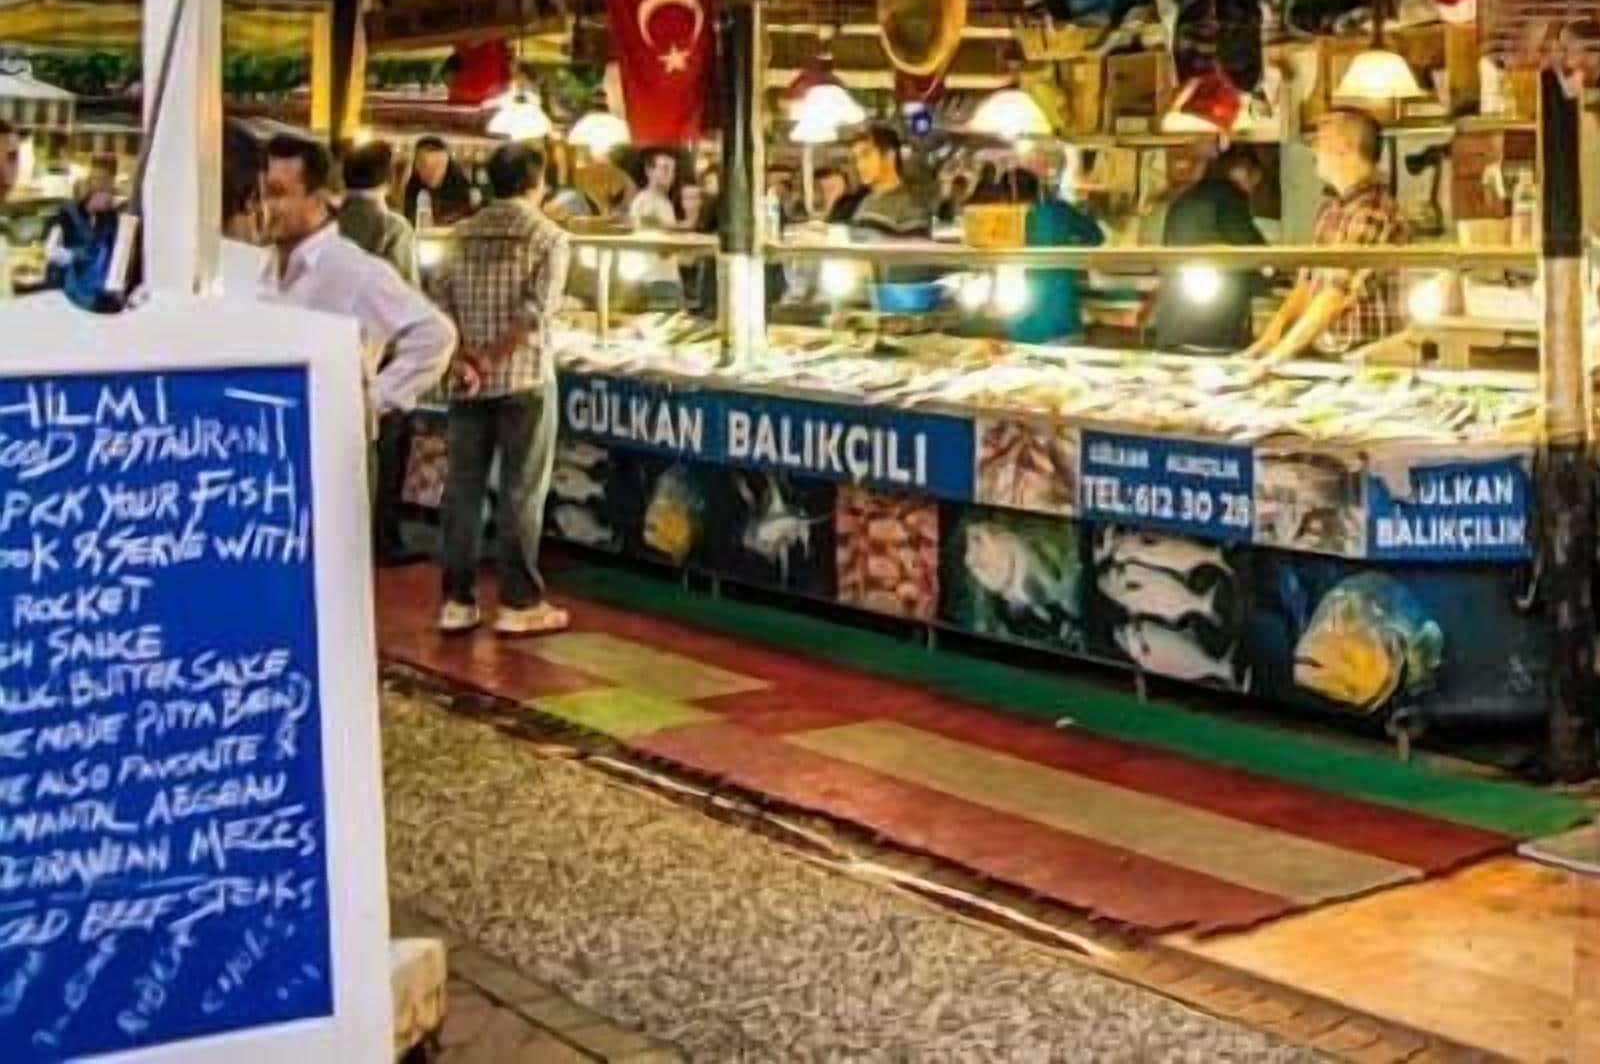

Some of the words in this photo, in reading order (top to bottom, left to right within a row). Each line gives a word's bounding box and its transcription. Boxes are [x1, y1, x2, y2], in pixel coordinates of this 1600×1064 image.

[566, 380, 702, 453] GÜLKAN
[1180, 487, 1213, 522] 30
[213, 511, 309, 563] WITH
